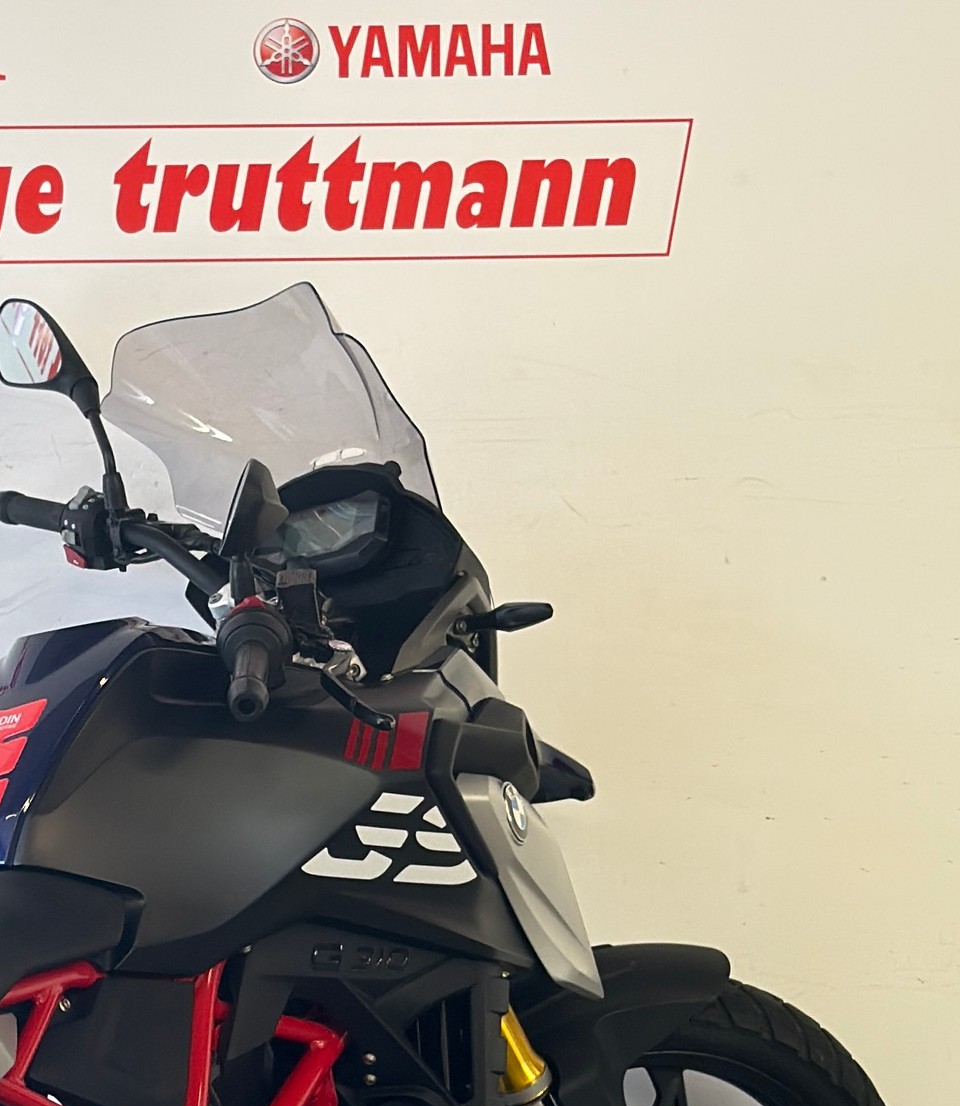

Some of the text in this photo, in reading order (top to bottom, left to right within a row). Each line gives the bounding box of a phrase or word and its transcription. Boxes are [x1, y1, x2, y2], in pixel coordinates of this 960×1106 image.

[329, 23, 551, 78] YAMAHA
[113, 135, 637, 235] truttmann
[311, 943, 410, 972] G 310
